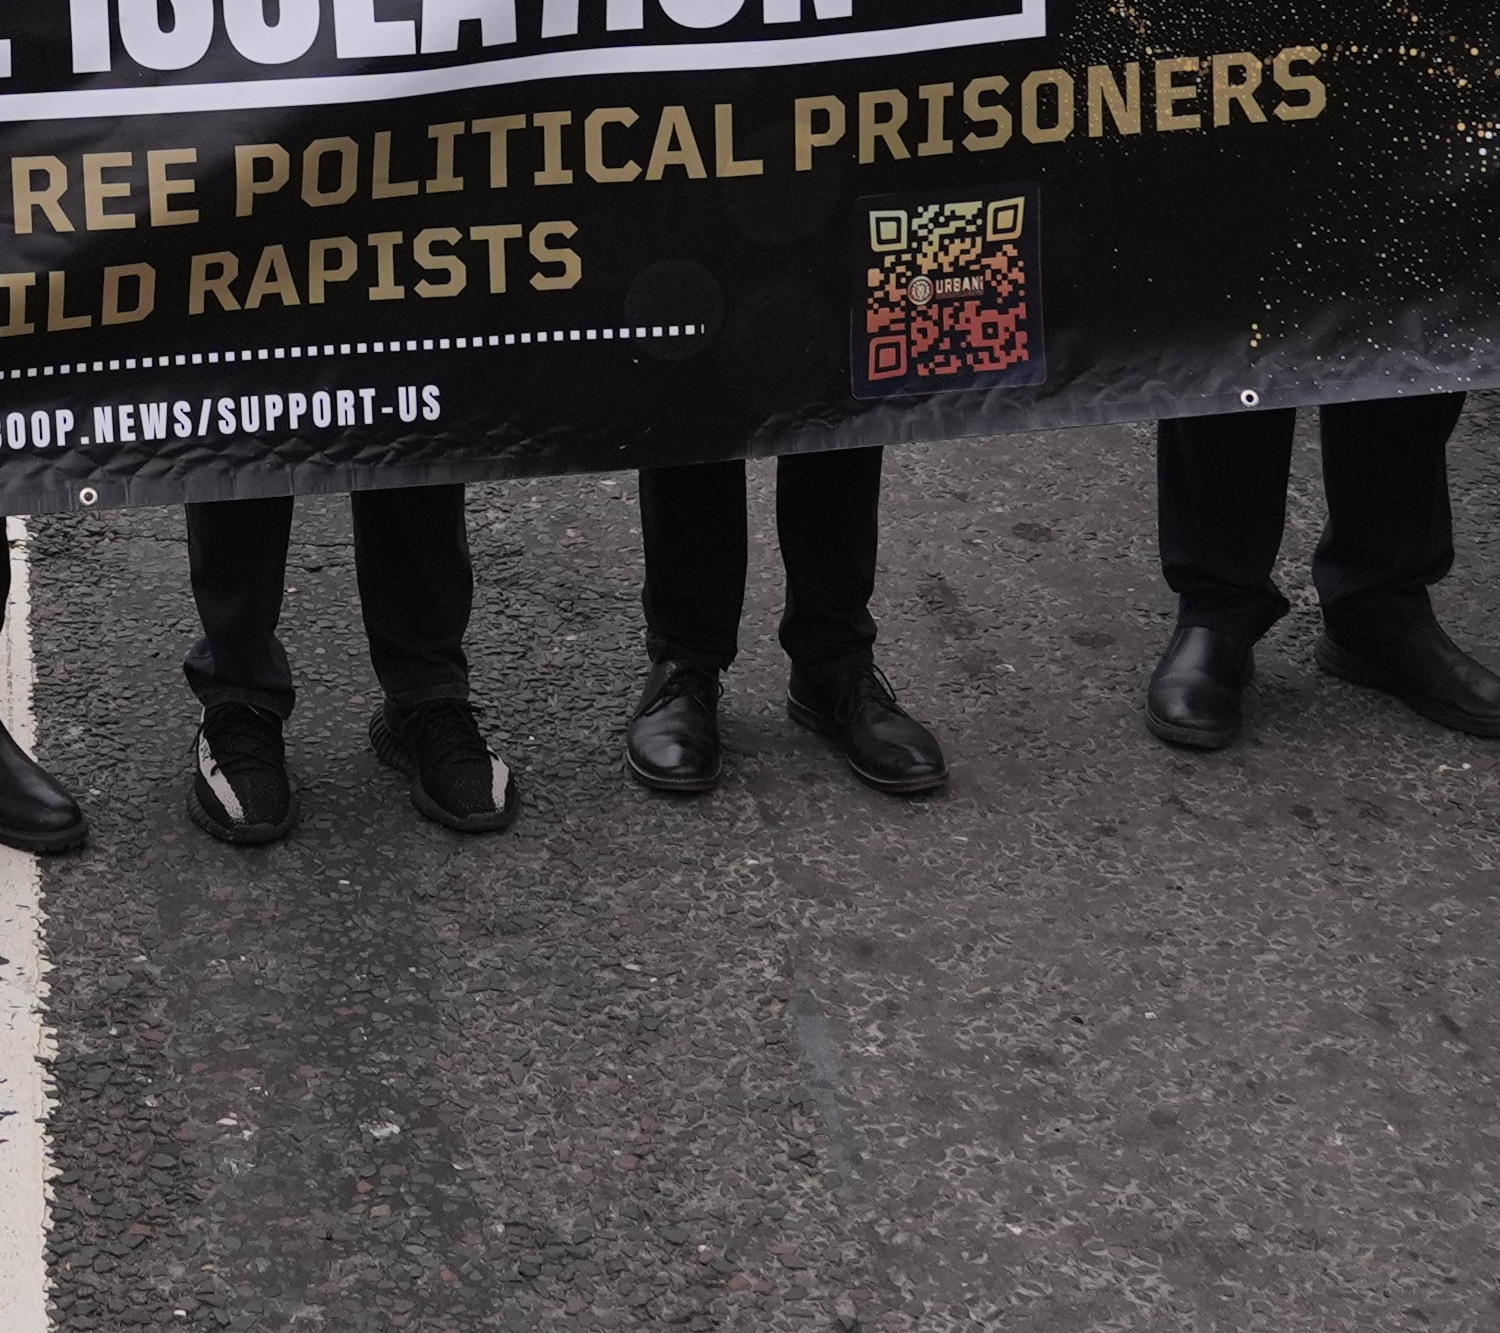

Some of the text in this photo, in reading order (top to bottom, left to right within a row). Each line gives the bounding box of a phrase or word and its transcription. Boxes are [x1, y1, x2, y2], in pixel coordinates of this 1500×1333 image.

[233, 103, 765, 218] POLITICAL
[793, 44, 1330, 173] PRISONERS
[188, 219, 584, 316] RAPISTS
